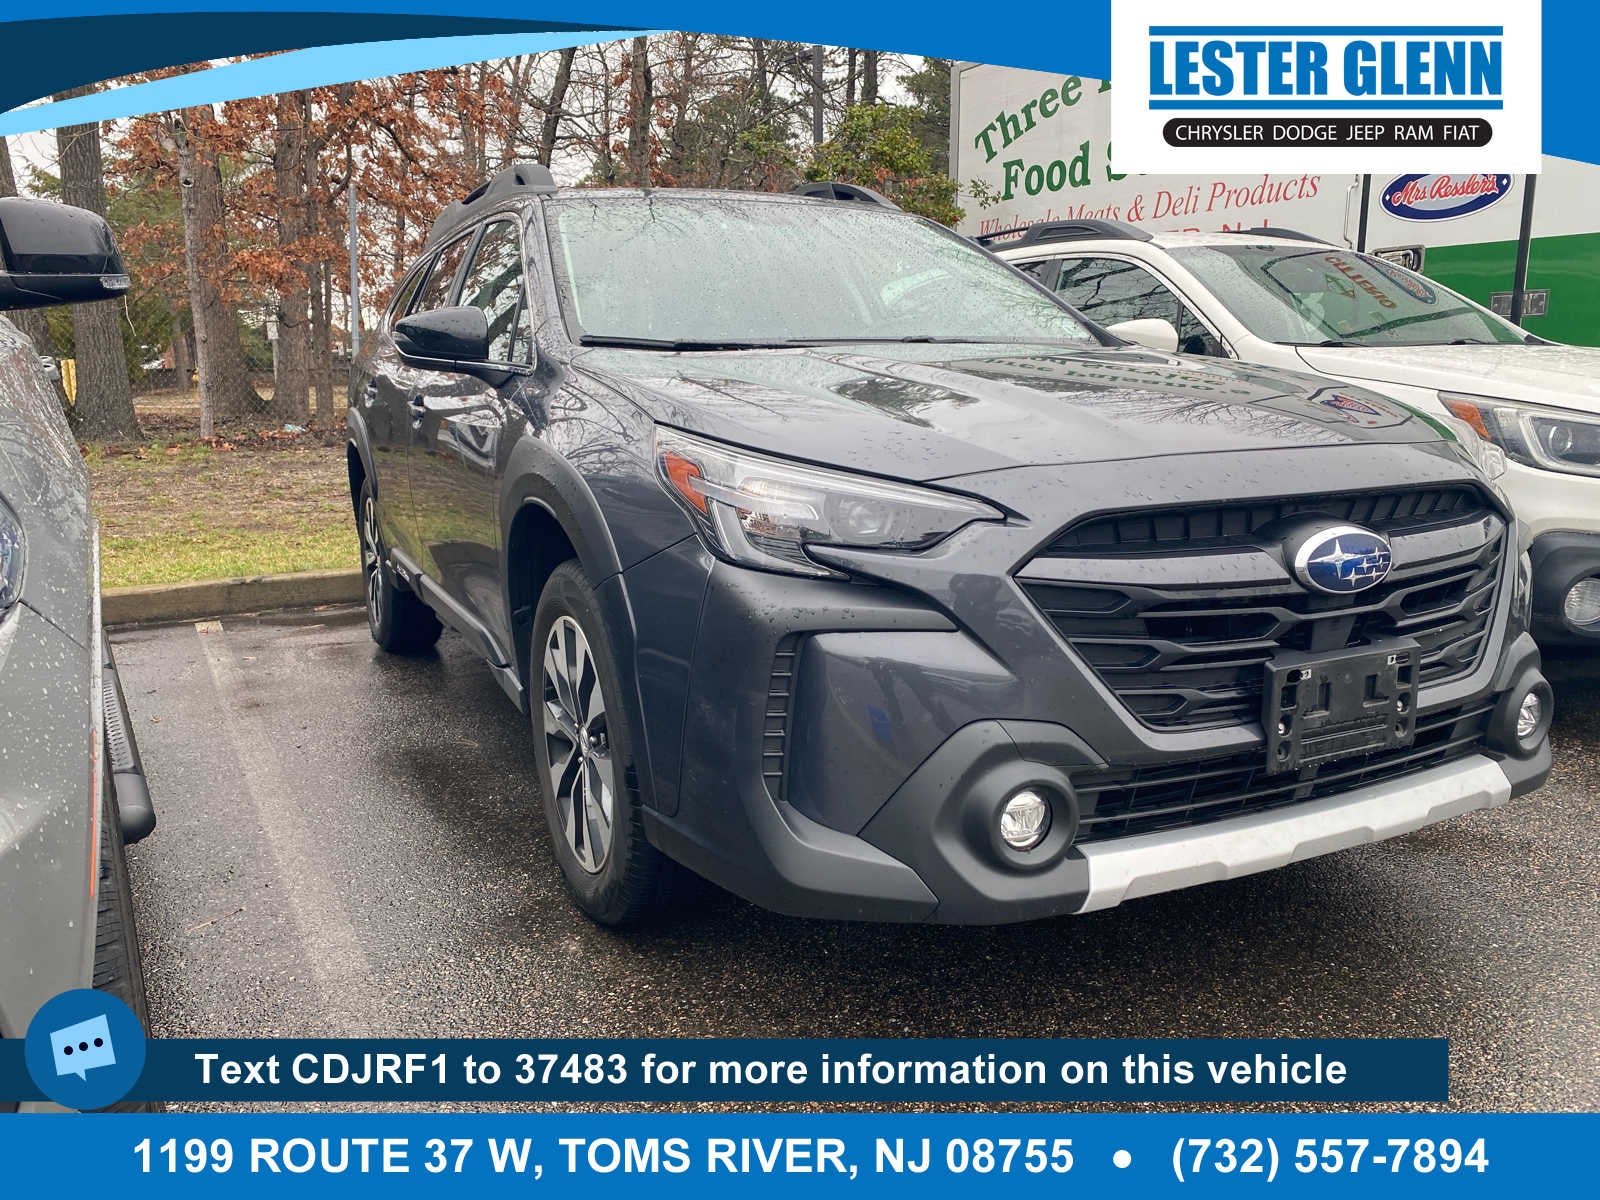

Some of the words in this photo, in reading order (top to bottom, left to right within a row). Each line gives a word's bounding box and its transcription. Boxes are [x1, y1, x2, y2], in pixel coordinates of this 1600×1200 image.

[975, 75, 1083, 163] Three
[1001, 140, 1091, 201] Food
[1391, 180, 1427, 206] Mrs
[980, 208, 1060, 241] Wholel
[1127, 194, 1145, 223] &
[1152, 184, 1201, 220] Deli
[1206, 174, 1322, 212] Products
